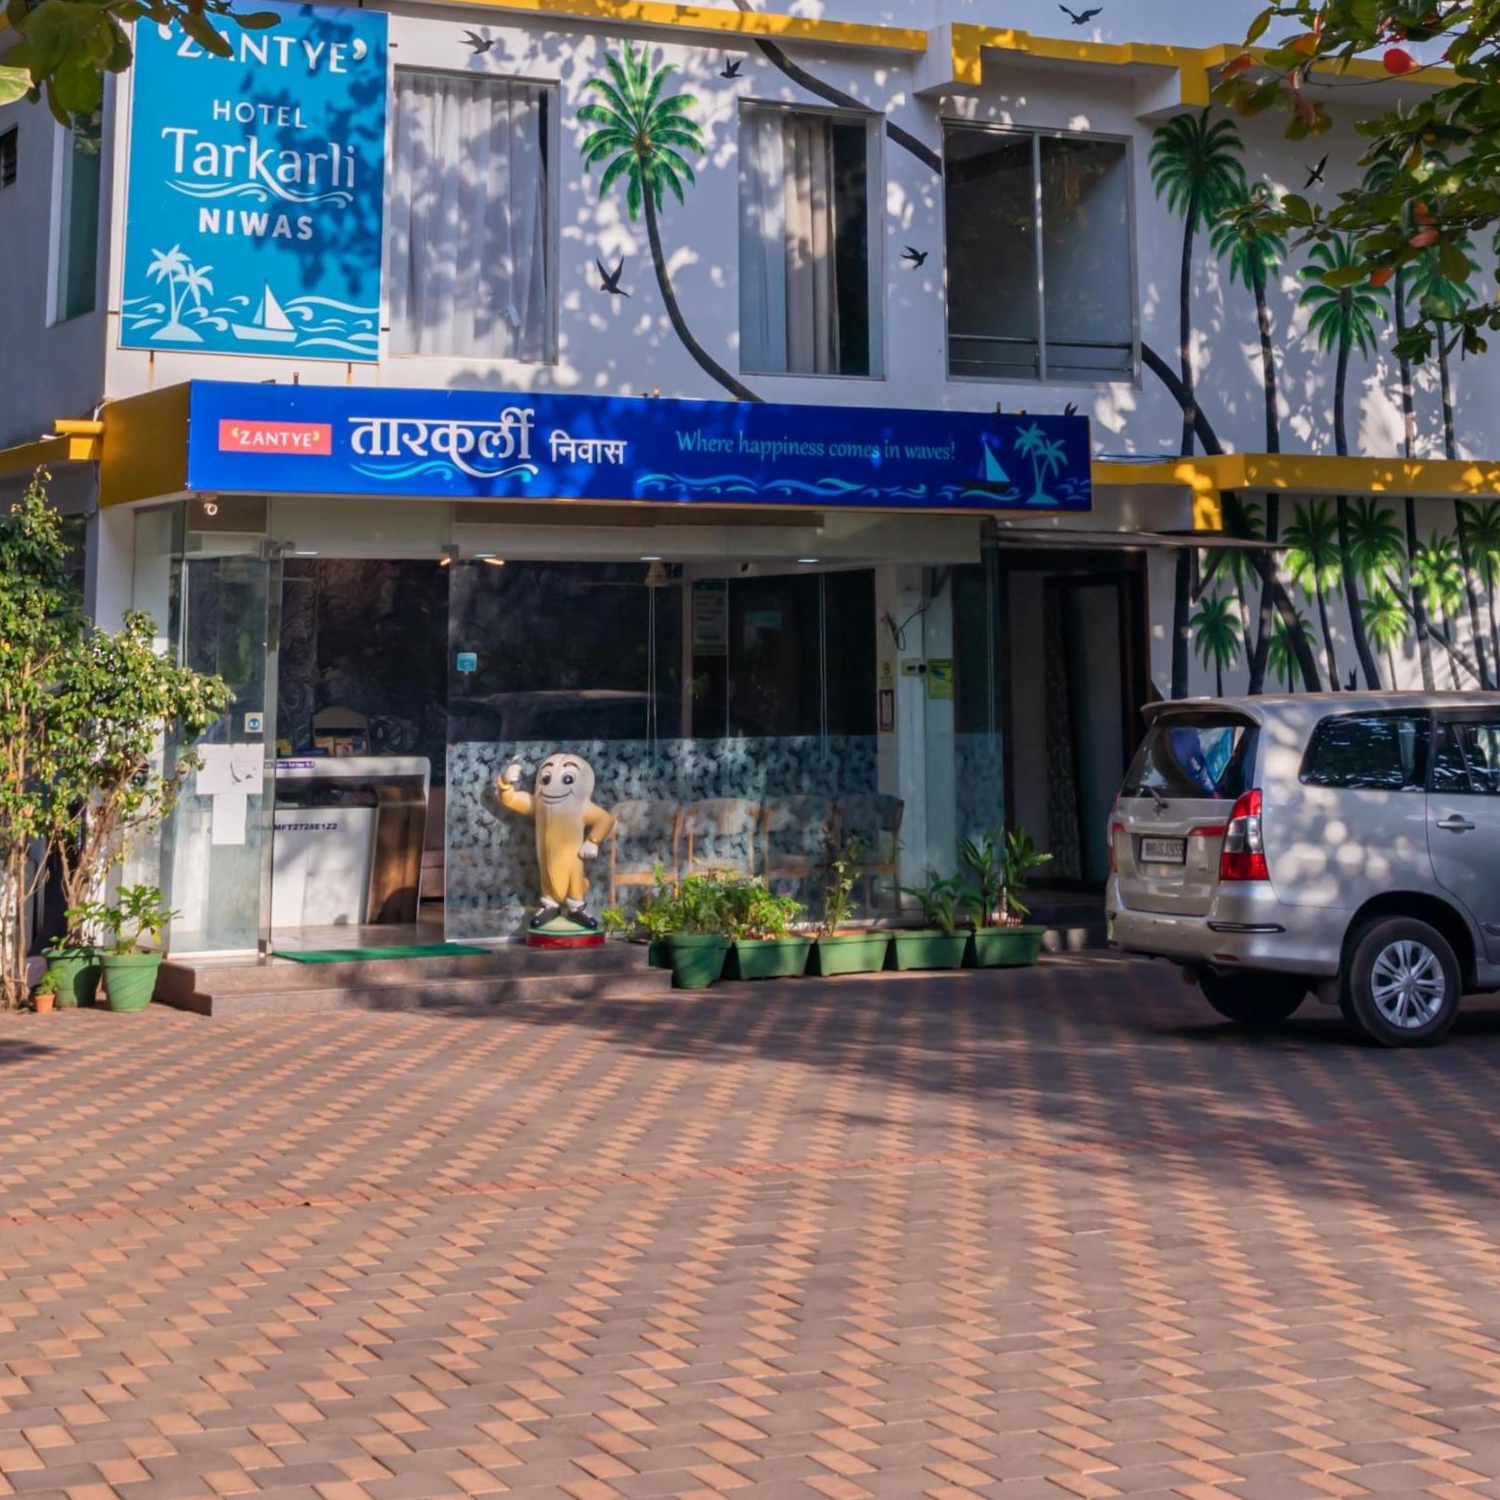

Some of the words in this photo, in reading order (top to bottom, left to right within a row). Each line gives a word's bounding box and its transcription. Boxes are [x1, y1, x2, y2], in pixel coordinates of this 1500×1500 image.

[212, 99, 308, 129] HOTEL
[161, 127, 355, 202] Tarkarli
[198, 207, 314, 241] NIWAS
[348, 406, 539, 478] तारकर्ली
[548, 428, 628, 465] निवास
[675, 428, 734, 453] Where
[738, 429, 825, 462] happiness
[828, 441, 880, 457] comes
[884, 438, 901, 458] in
[903, 439, 956, 461] waves!
